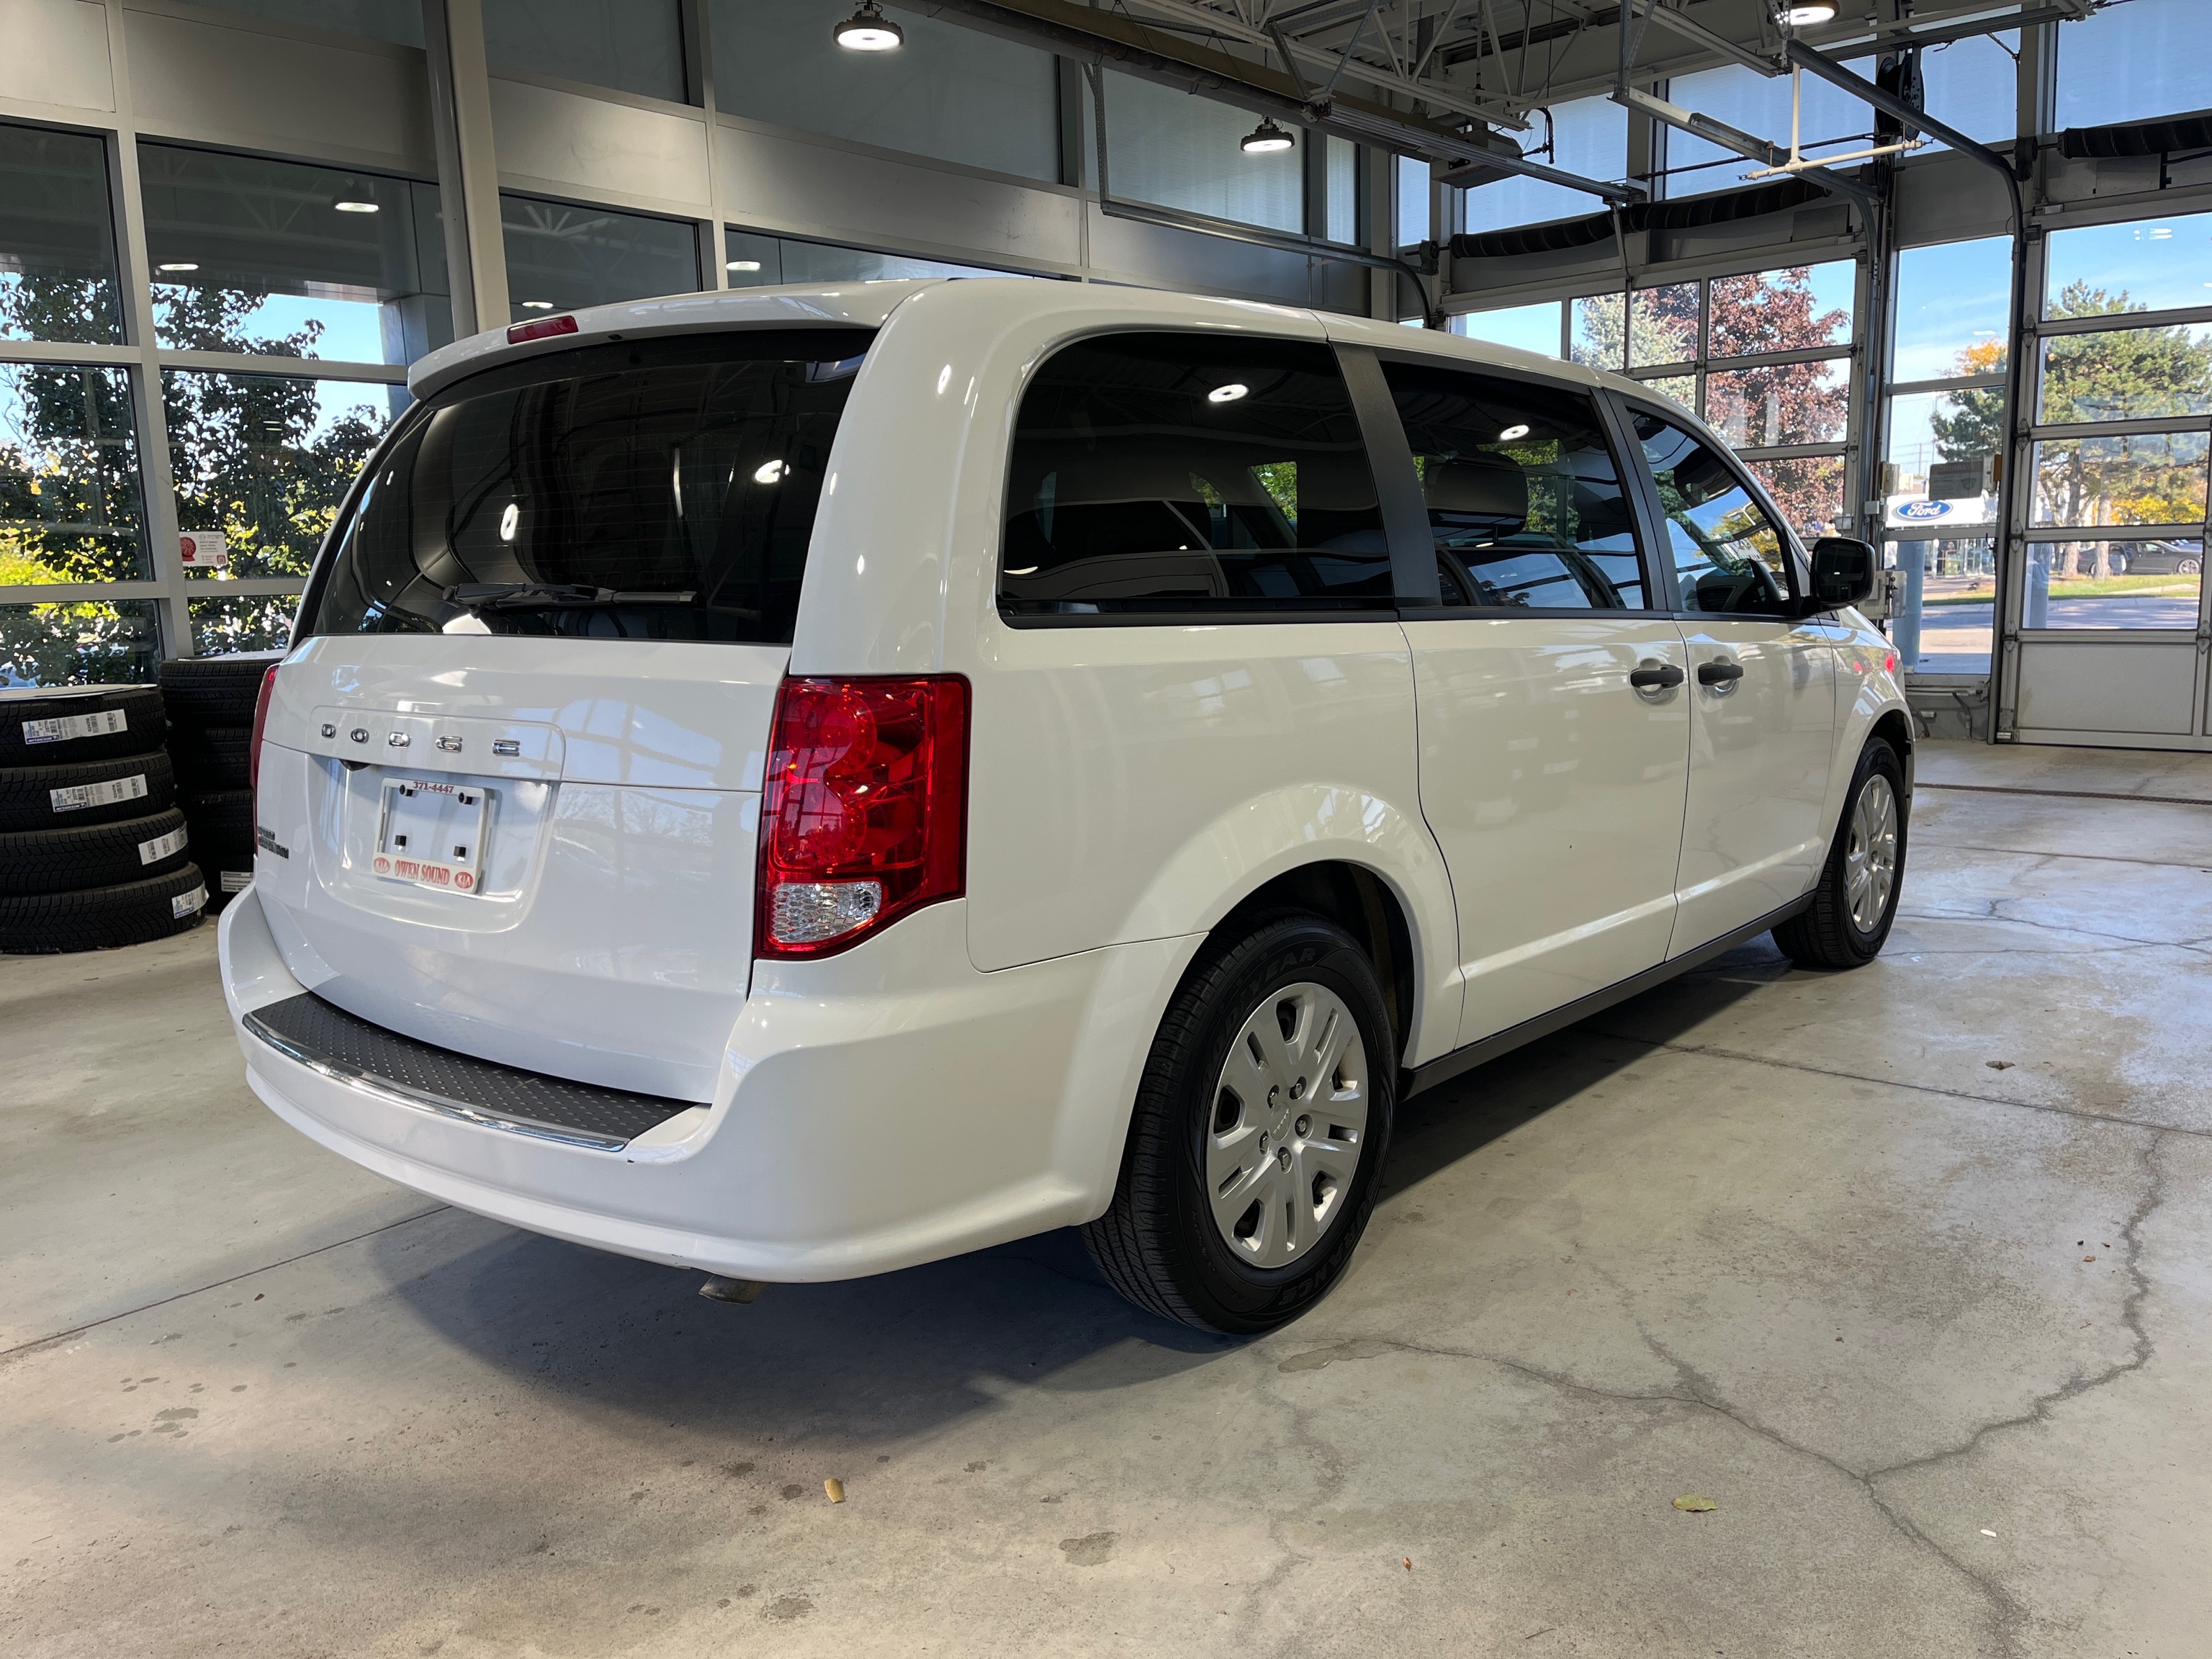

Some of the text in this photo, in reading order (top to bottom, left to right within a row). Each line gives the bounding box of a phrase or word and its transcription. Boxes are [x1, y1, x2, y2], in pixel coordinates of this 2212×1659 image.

[1907, 502, 1942, 516] Ford
[321, 723, 521, 757] DODGE
[413, 781, 454, 793] 371-4447
[395, 860, 420, 880] OWEN
[421, 864, 450, 886] SOUND
[455, 873, 472, 888] KIA
[1194, 948, 1316, 1126] GOODYEAR
